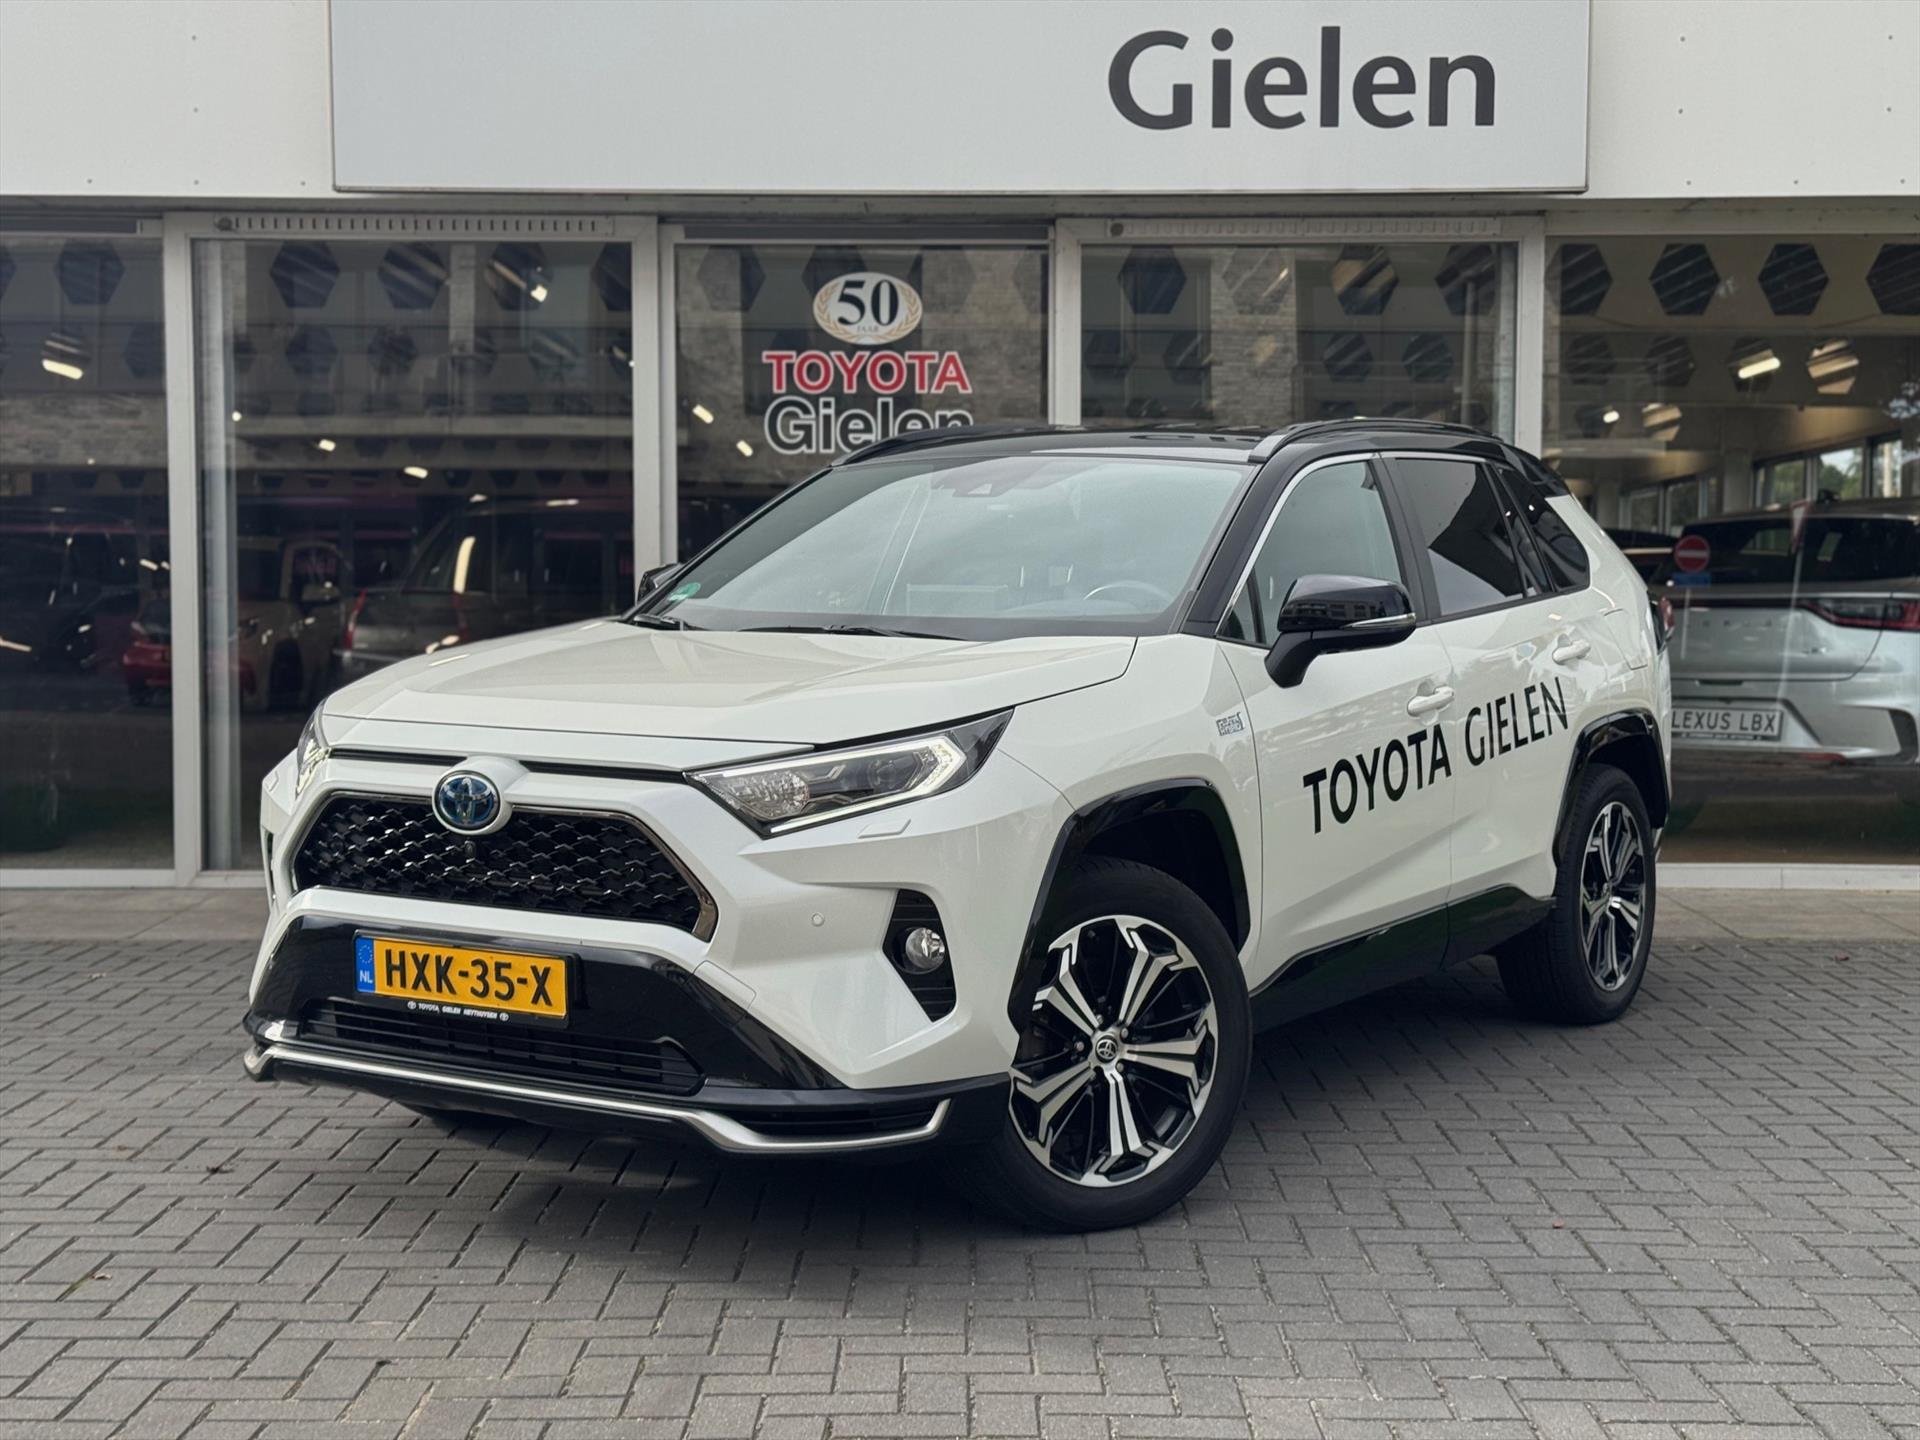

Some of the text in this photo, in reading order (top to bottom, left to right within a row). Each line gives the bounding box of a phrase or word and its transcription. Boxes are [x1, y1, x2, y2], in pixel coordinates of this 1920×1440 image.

[1108, 26, 1495, 130] Gielen
[837, 279, 899, 326] 50
[762, 350, 973, 394] TOYOTA
[1671, 710, 1776, 733] LEXUS LBX
[1302, 676, 1569, 834] TOYOTA GIELEN
[359, 970, 373, 984] NL
[385, 949, 553, 1007] HXK-35-X
